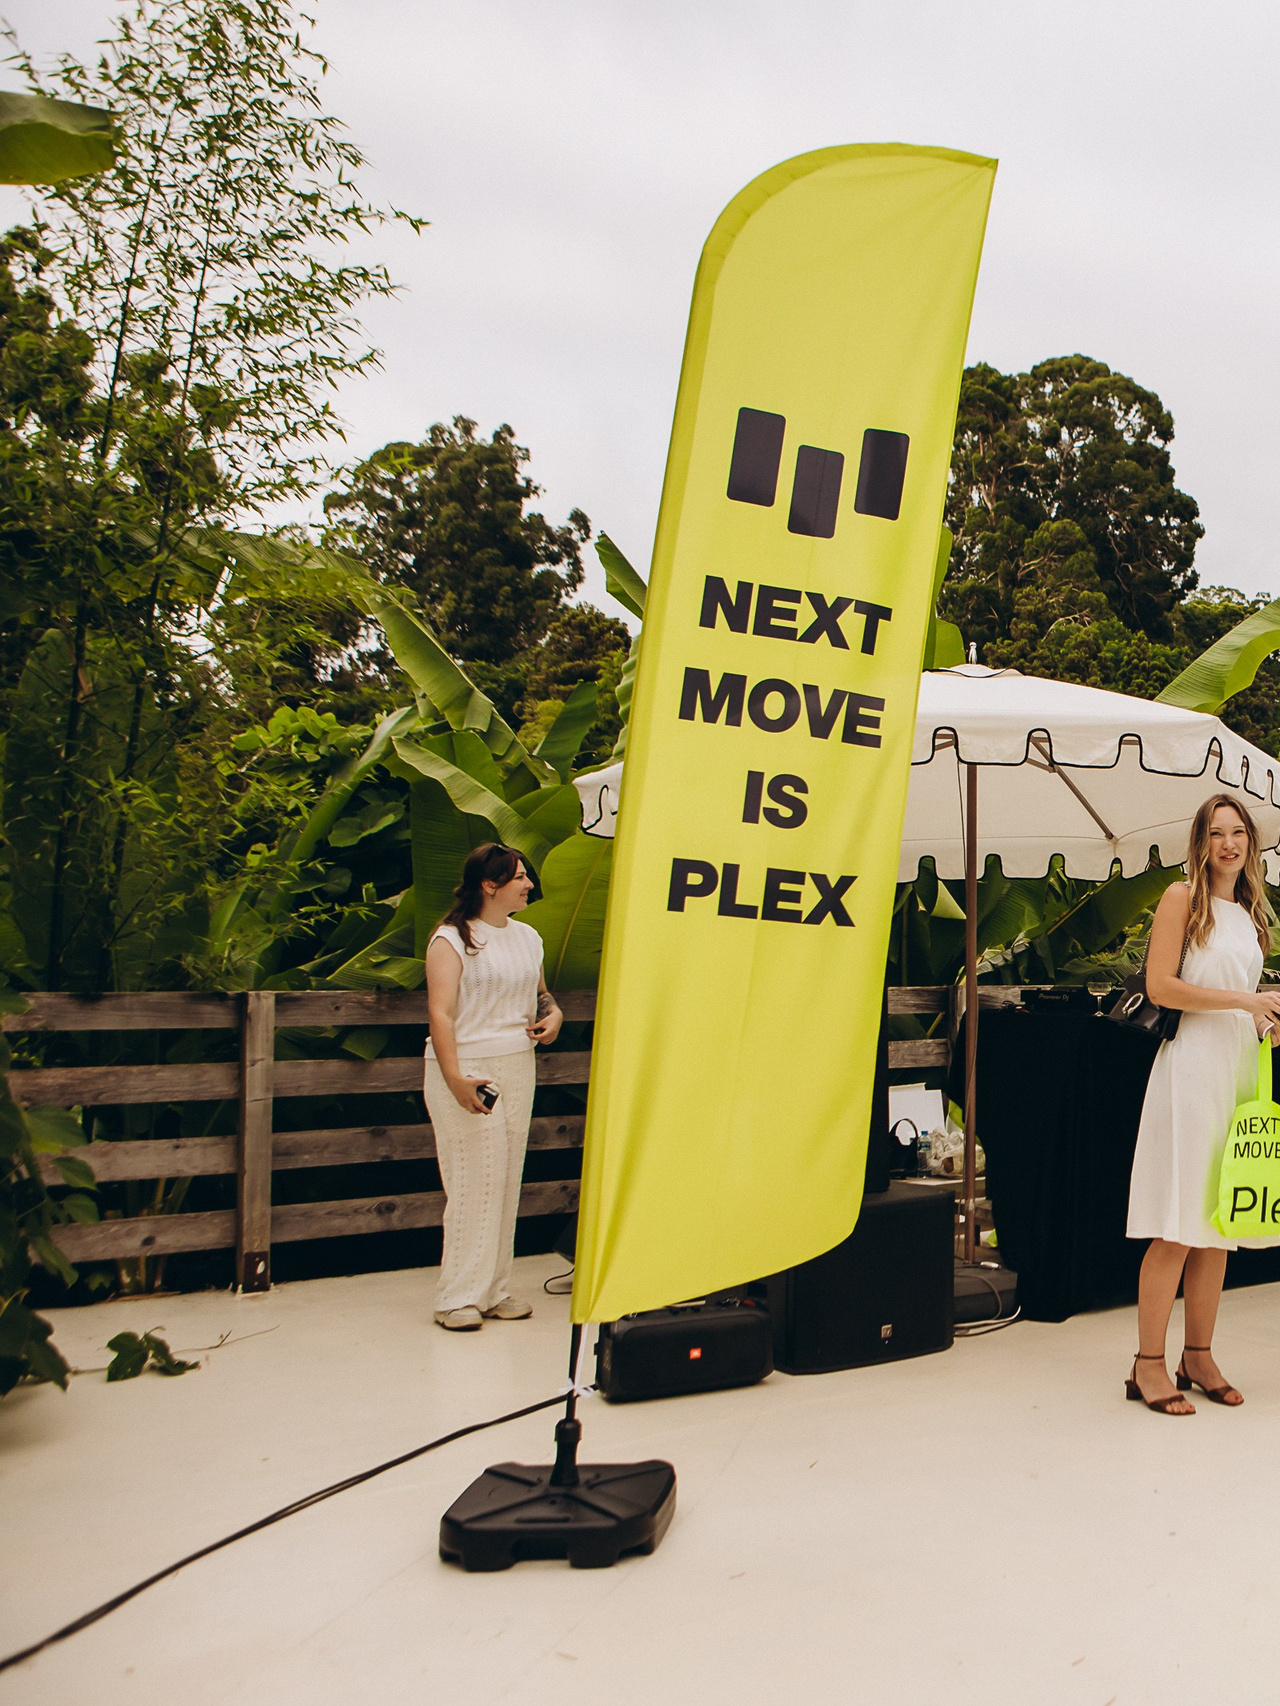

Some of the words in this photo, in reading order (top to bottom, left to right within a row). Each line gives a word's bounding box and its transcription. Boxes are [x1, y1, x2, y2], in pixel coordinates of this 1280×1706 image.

[699, 575, 892, 655] NEXT
[678, 666, 885, 748] MOVE
[742, 770, 809, 829] IS
[667, 857, 858, 927] PLEX
[1236, 1117, 1280, 1137] NEXT
